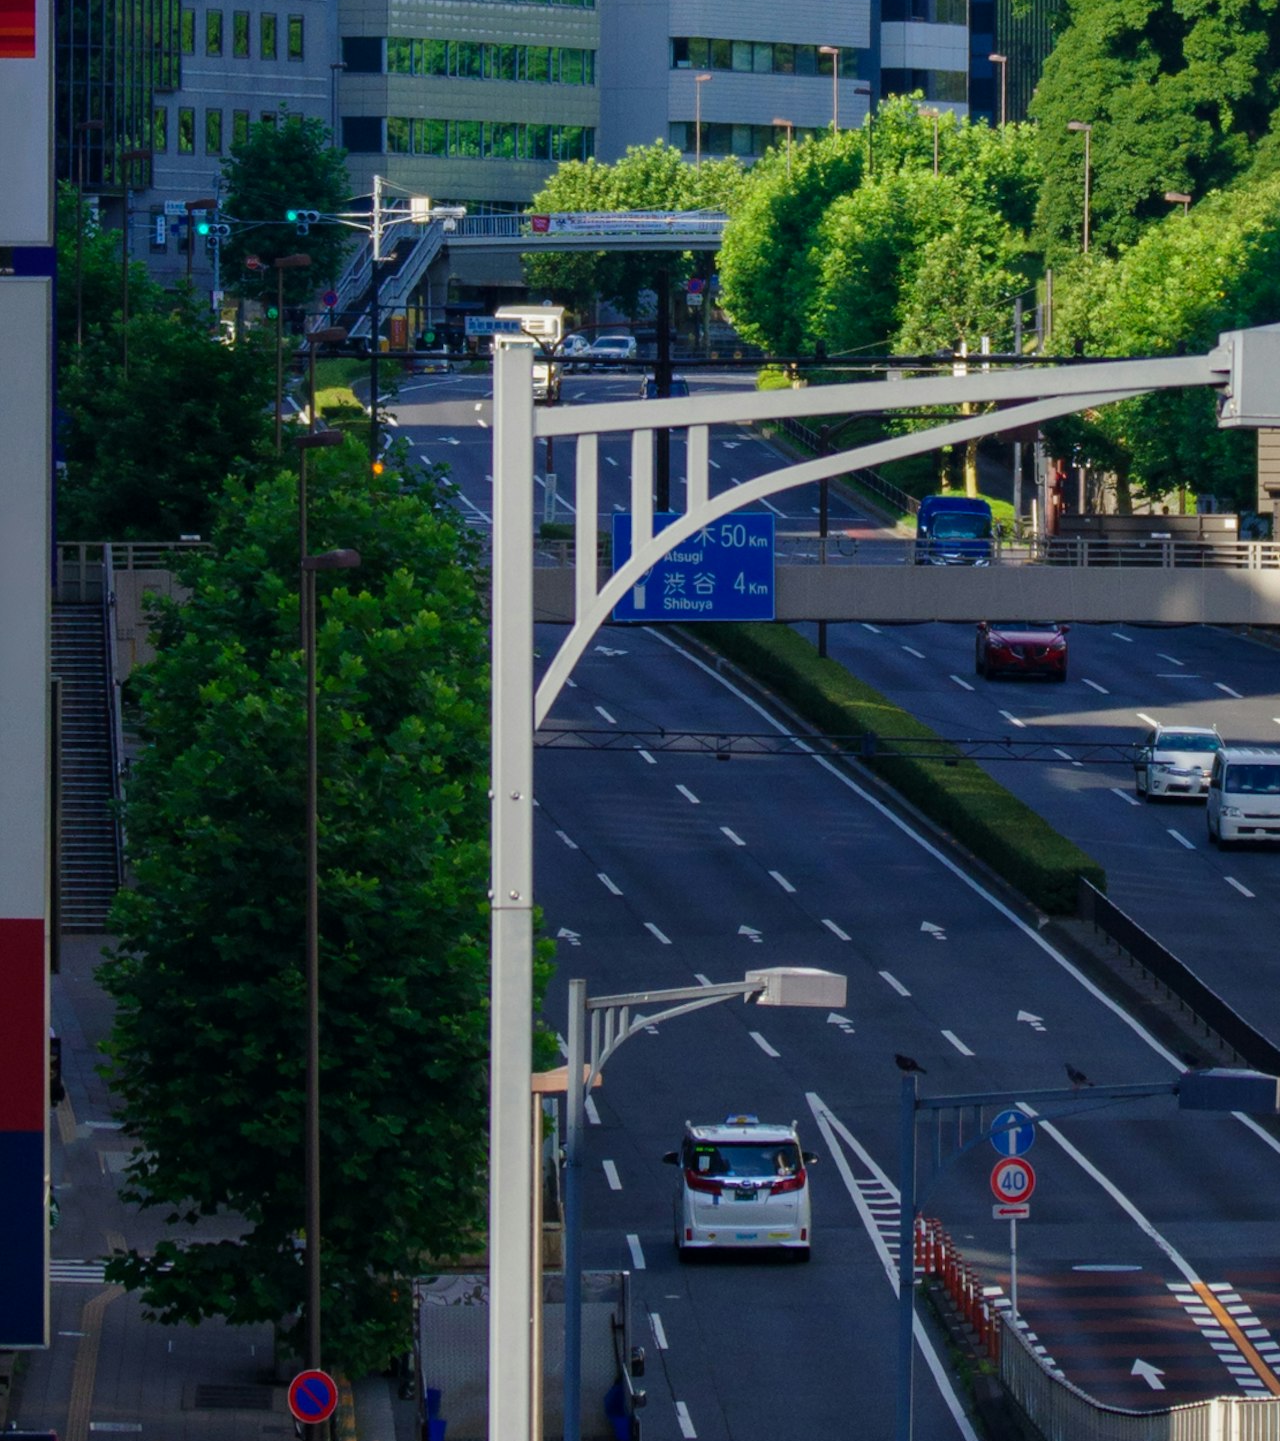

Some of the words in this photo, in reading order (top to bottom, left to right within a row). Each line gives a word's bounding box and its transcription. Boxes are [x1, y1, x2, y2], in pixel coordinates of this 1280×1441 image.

[721, 524, 746, 548] 50
[748, 535, 768, 547] Km
[664, 550, 703, 565] Atsugi
[664, 572, 716, 595] 渋谷
[733, 571, 746, 595] 4
[748, 583, 768, 595] Km
[663, 598, 713, 612] Shibuya
[1001, 1171, 1025, 1190] 40
